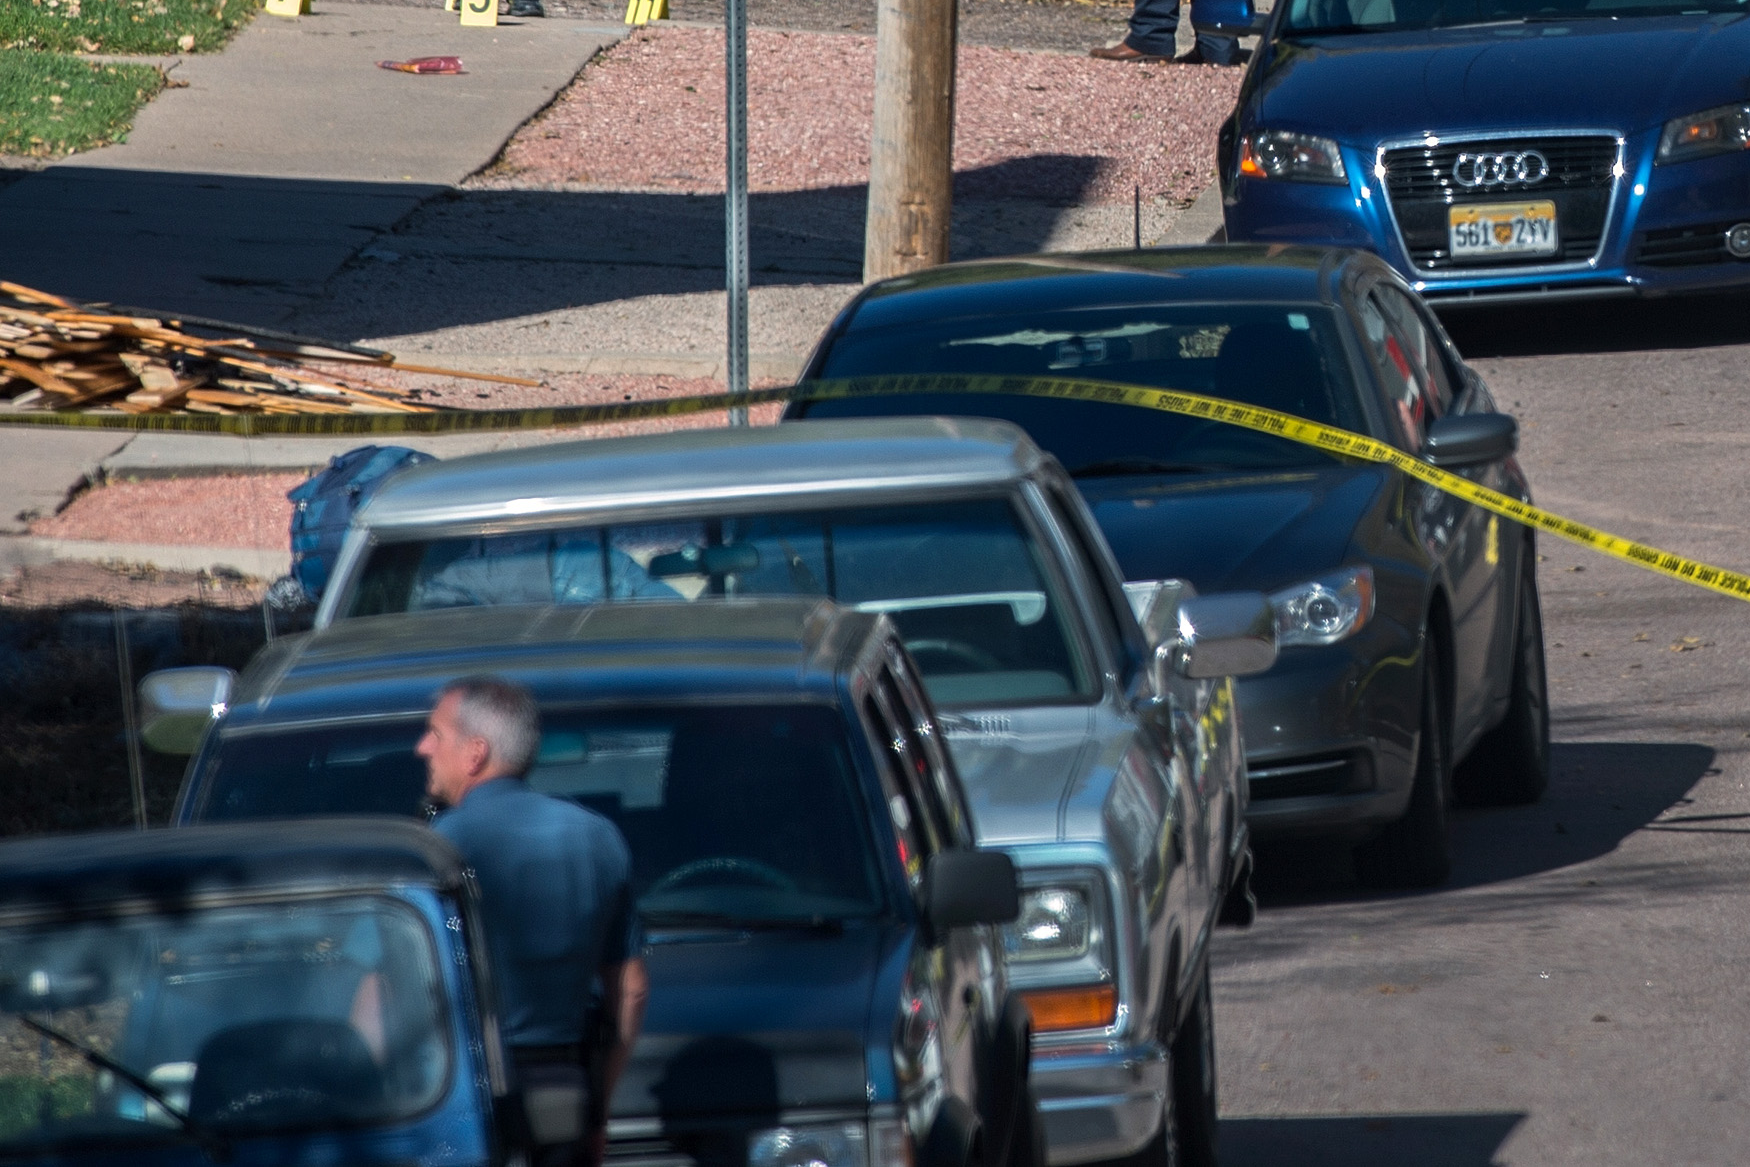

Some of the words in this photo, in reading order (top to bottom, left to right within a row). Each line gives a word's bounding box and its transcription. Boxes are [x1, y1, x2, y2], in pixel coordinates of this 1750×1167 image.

[1627, 544, 1659, 564] CROSS
[1660, 554, 1681, 572] NOT
[1680, 560, 1696, 577] DO
[1696, 566, 1720, 585] LINE
